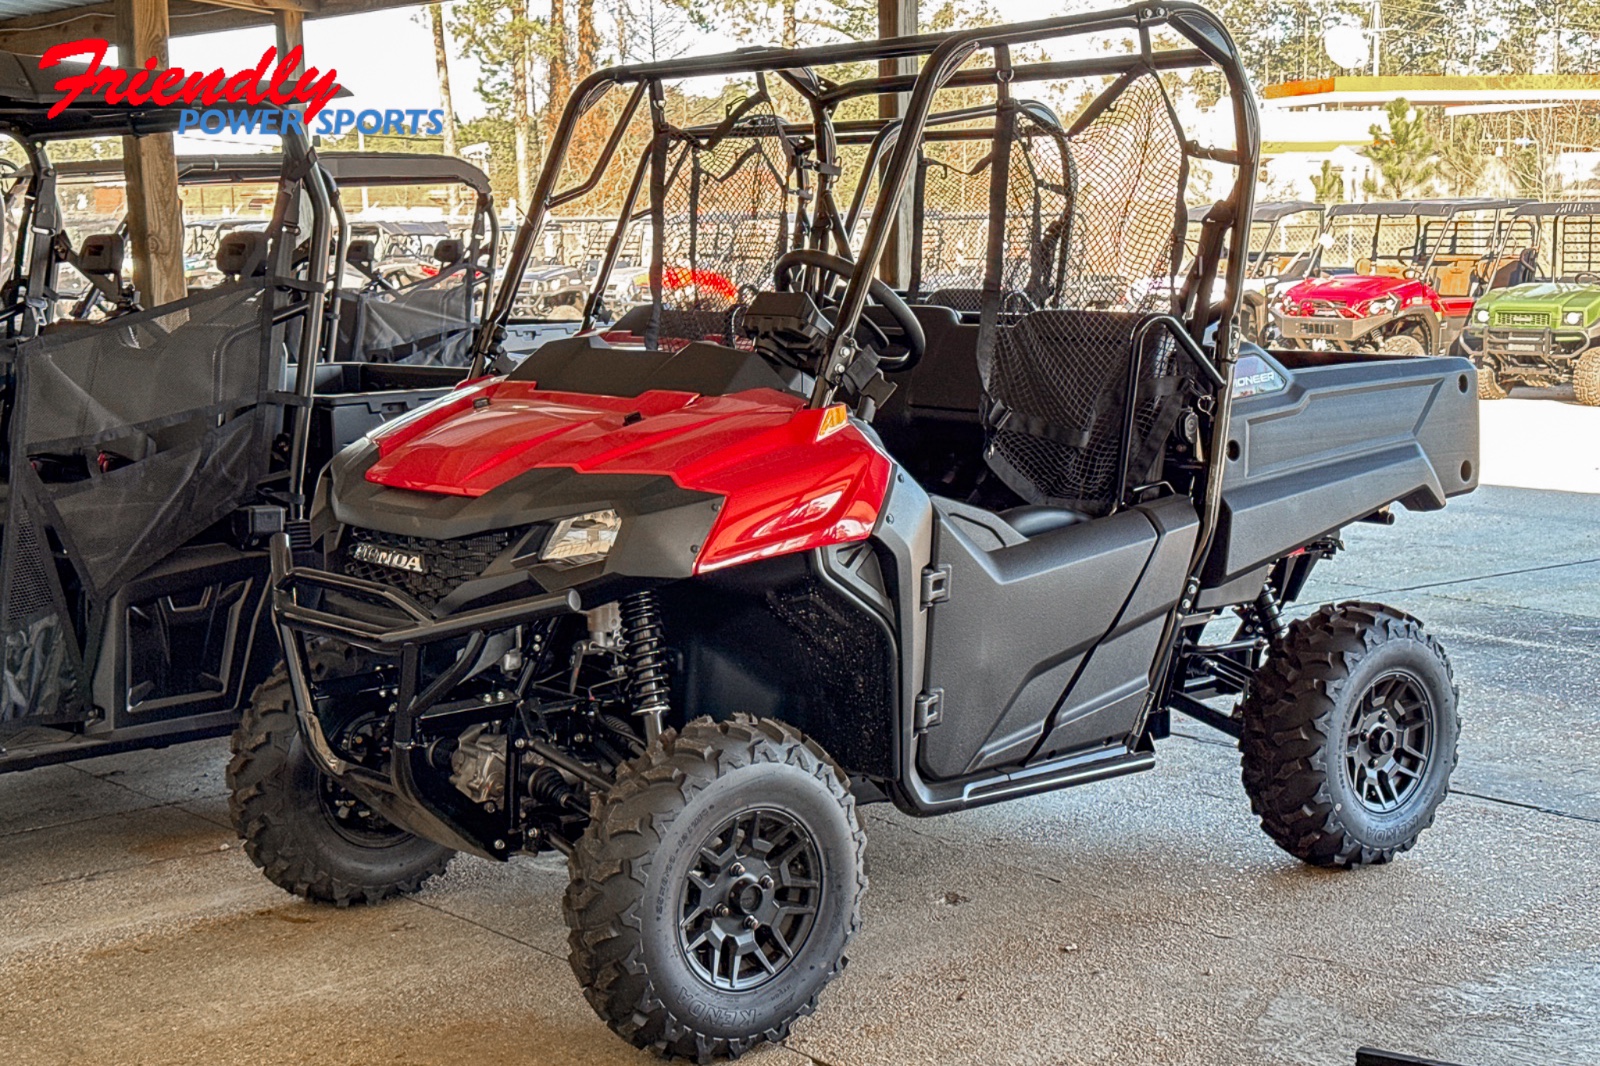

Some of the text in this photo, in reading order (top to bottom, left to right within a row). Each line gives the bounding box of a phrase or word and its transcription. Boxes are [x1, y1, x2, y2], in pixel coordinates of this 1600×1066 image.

[1233, 372, 1275, 387] IONEER
[354, 542, 423, 573] HONDA
[677, 986, 757, 1028] KENDA
